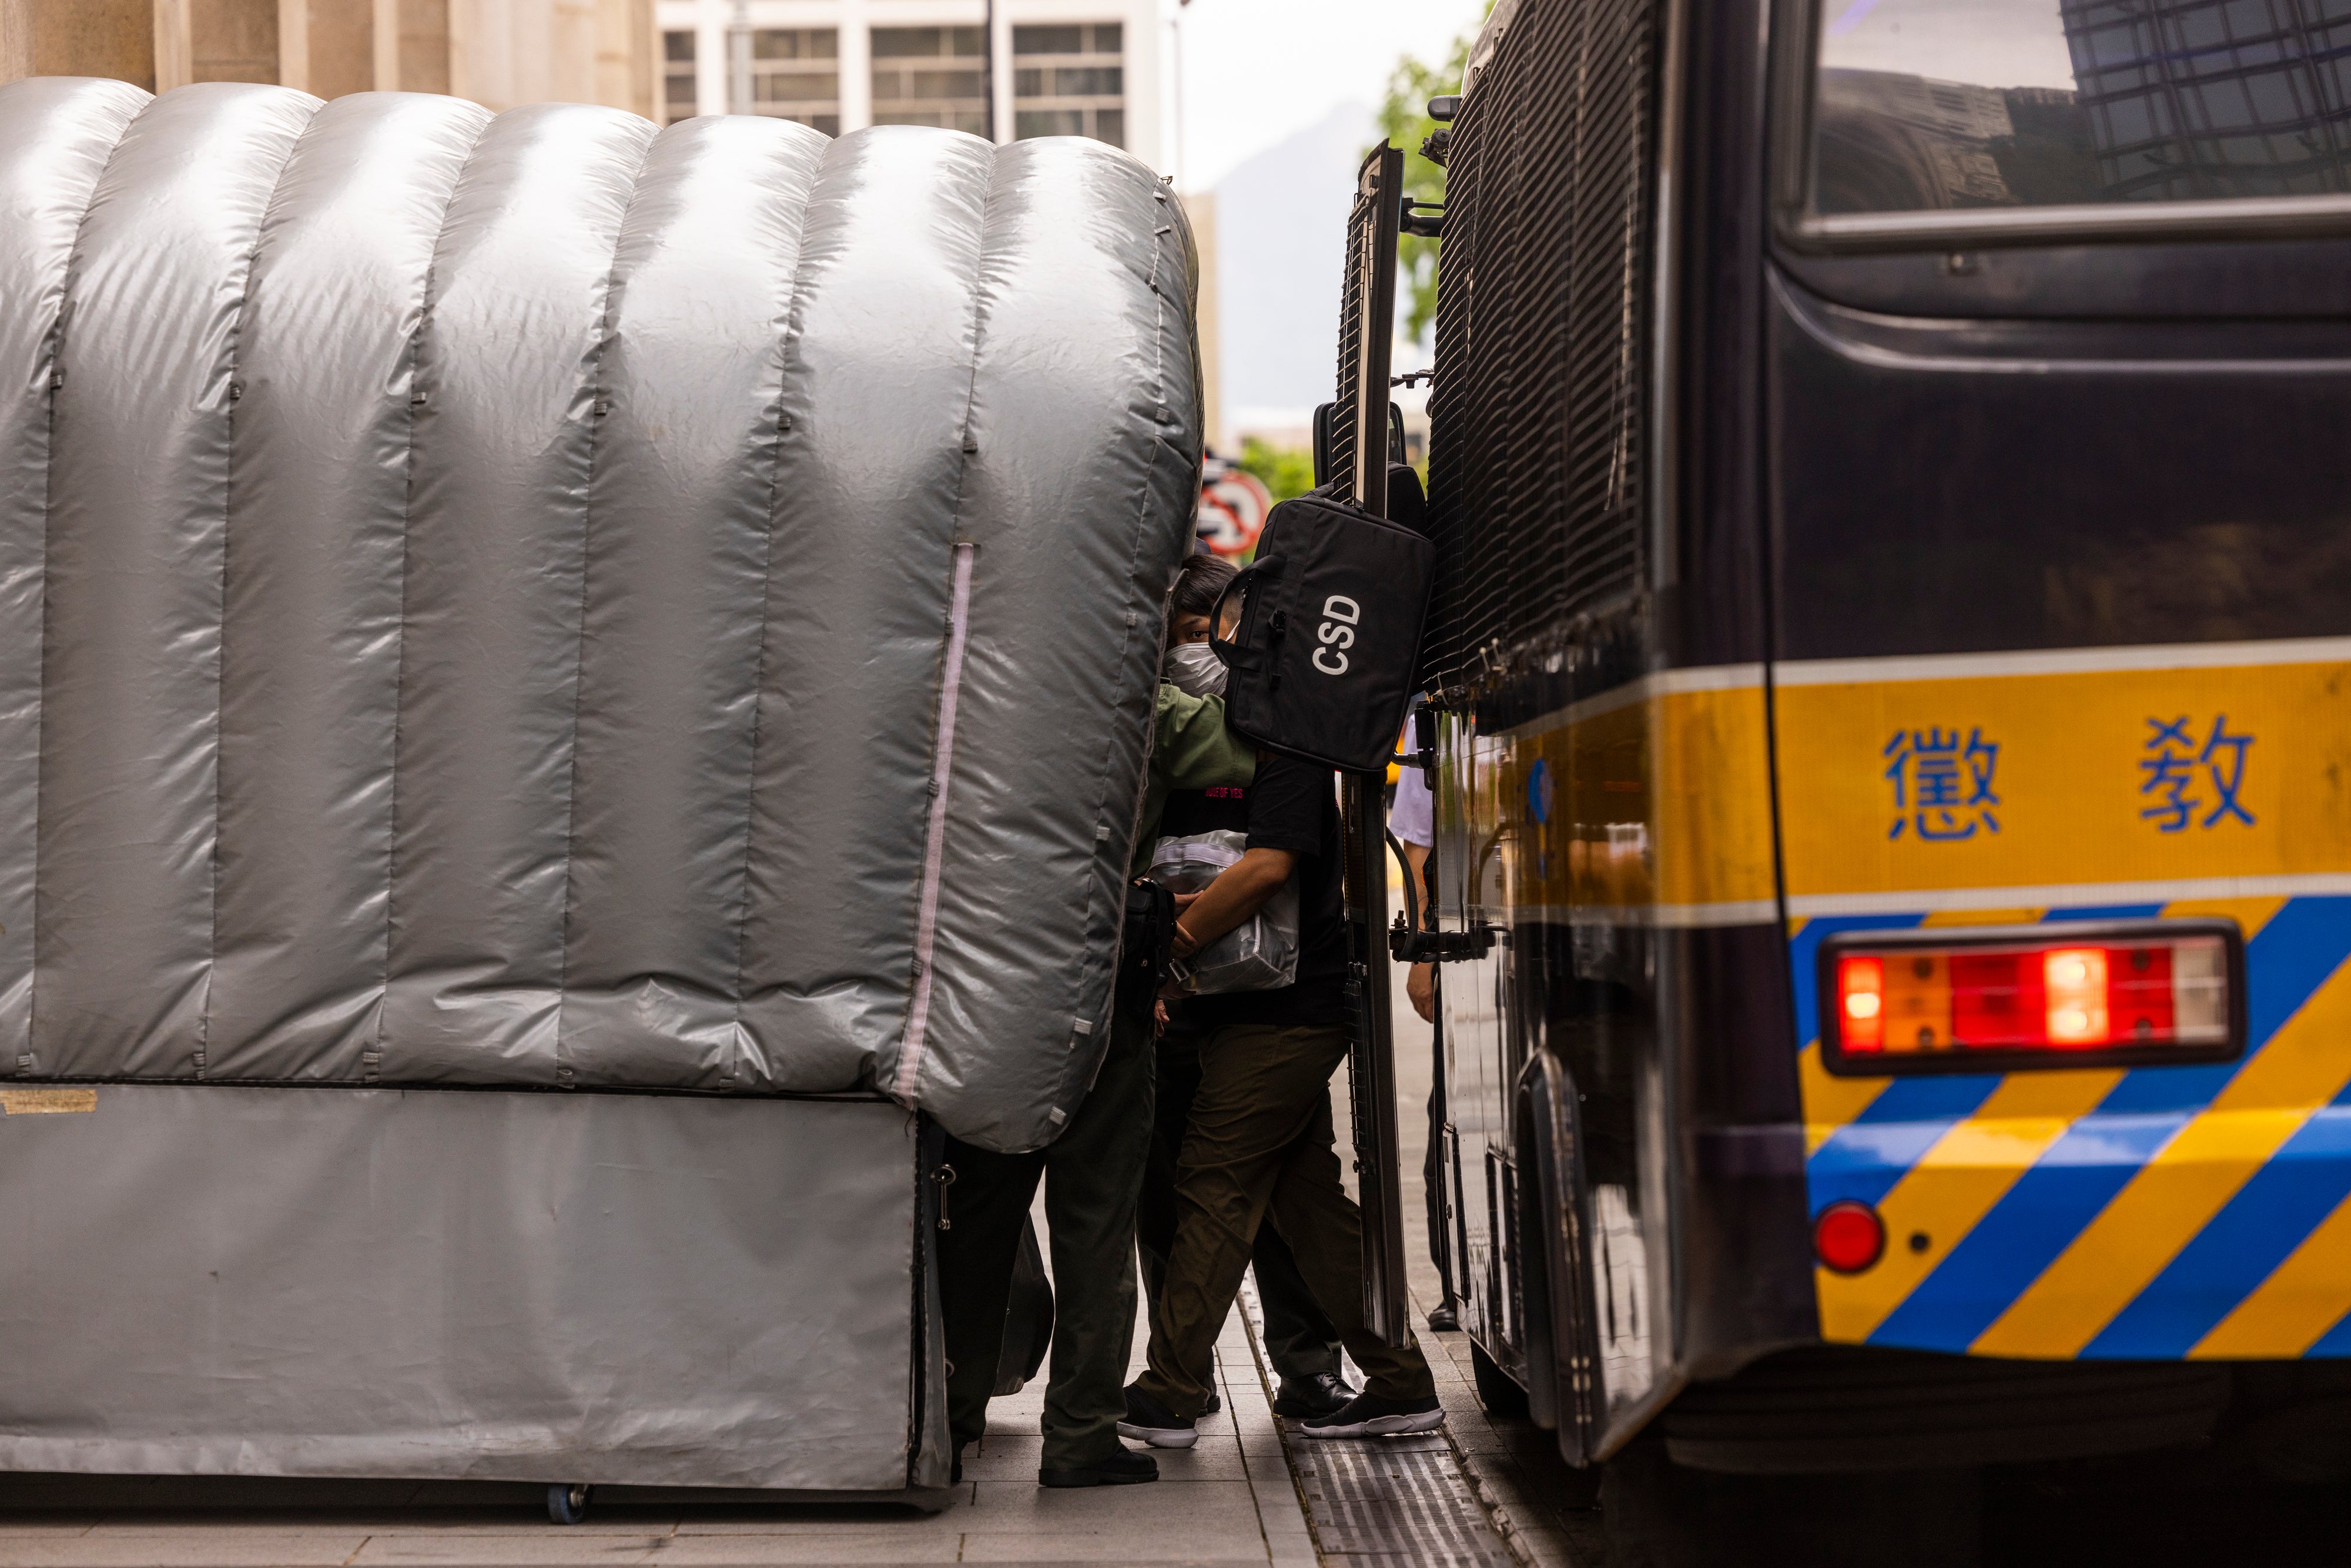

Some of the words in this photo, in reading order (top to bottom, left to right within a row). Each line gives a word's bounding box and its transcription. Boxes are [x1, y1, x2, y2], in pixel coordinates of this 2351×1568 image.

[1312, 595, 1360, 675] CSD
[1205, 788, 1219, 797] USE
[1220, 788, 1228, 798] OF
[1230, 788, 1243, 799] YES
